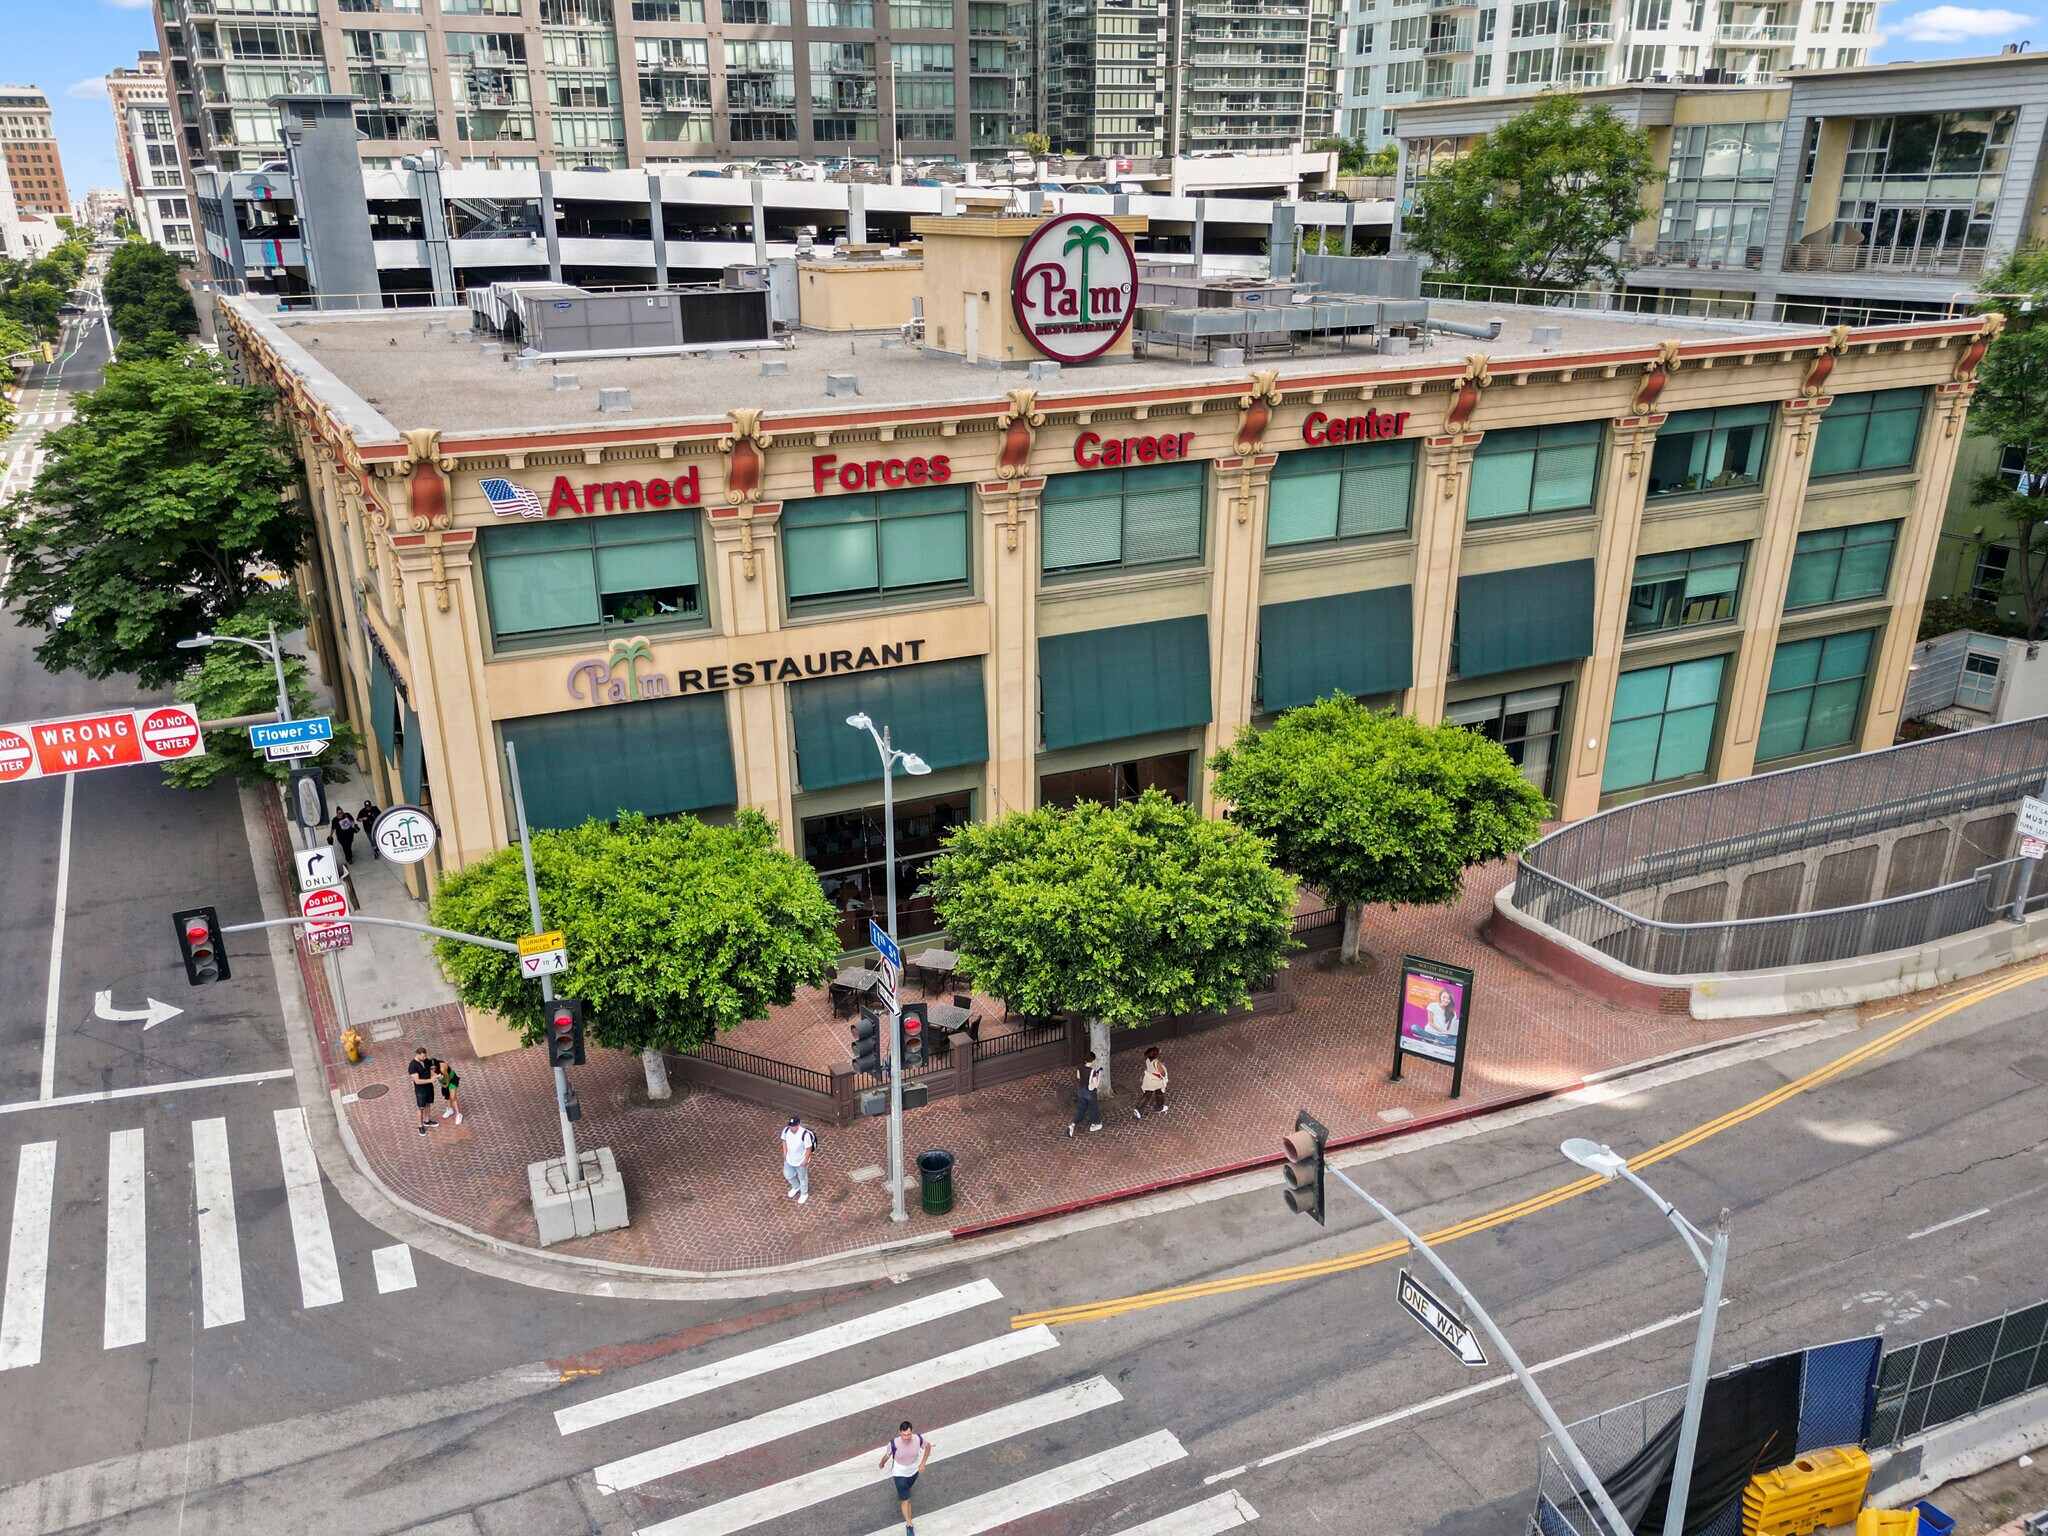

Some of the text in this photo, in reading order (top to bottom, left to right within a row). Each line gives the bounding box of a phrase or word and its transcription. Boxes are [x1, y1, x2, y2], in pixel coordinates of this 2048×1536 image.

[1021, 225, 1122, 323] Palm
[219, 325, 236, 334] Ara
[1034, 320, 1121, 336] RESTAURANT
[546, 407, 1411, 517] Armed Forces Career Center
[567, 635, 925, 705] Palm RESTAURANT
[148, 715, 188, 730] DO NOT
[41, 720, 129, 747] WRONG
[257, 723, 324, 742] Flower St
[155, 737, 191, 751] ENTER
[273, 744, 310, 755] ONE WAY
[62, 744, 117, 766] WAY
[380, 816, 429, 848] Palm
[305, 874, 333, 888] ONLY
[308, 894, 338, 907] DO NOT
[310, 926, 350, 942] WRONG
[522, 937, 549, 946] TURNING
[319, 937, 343, 950] WAY
[522, 944, 551, 954] VEHICLES
[1404, 1285, 1464, 1346] ONE WAY
